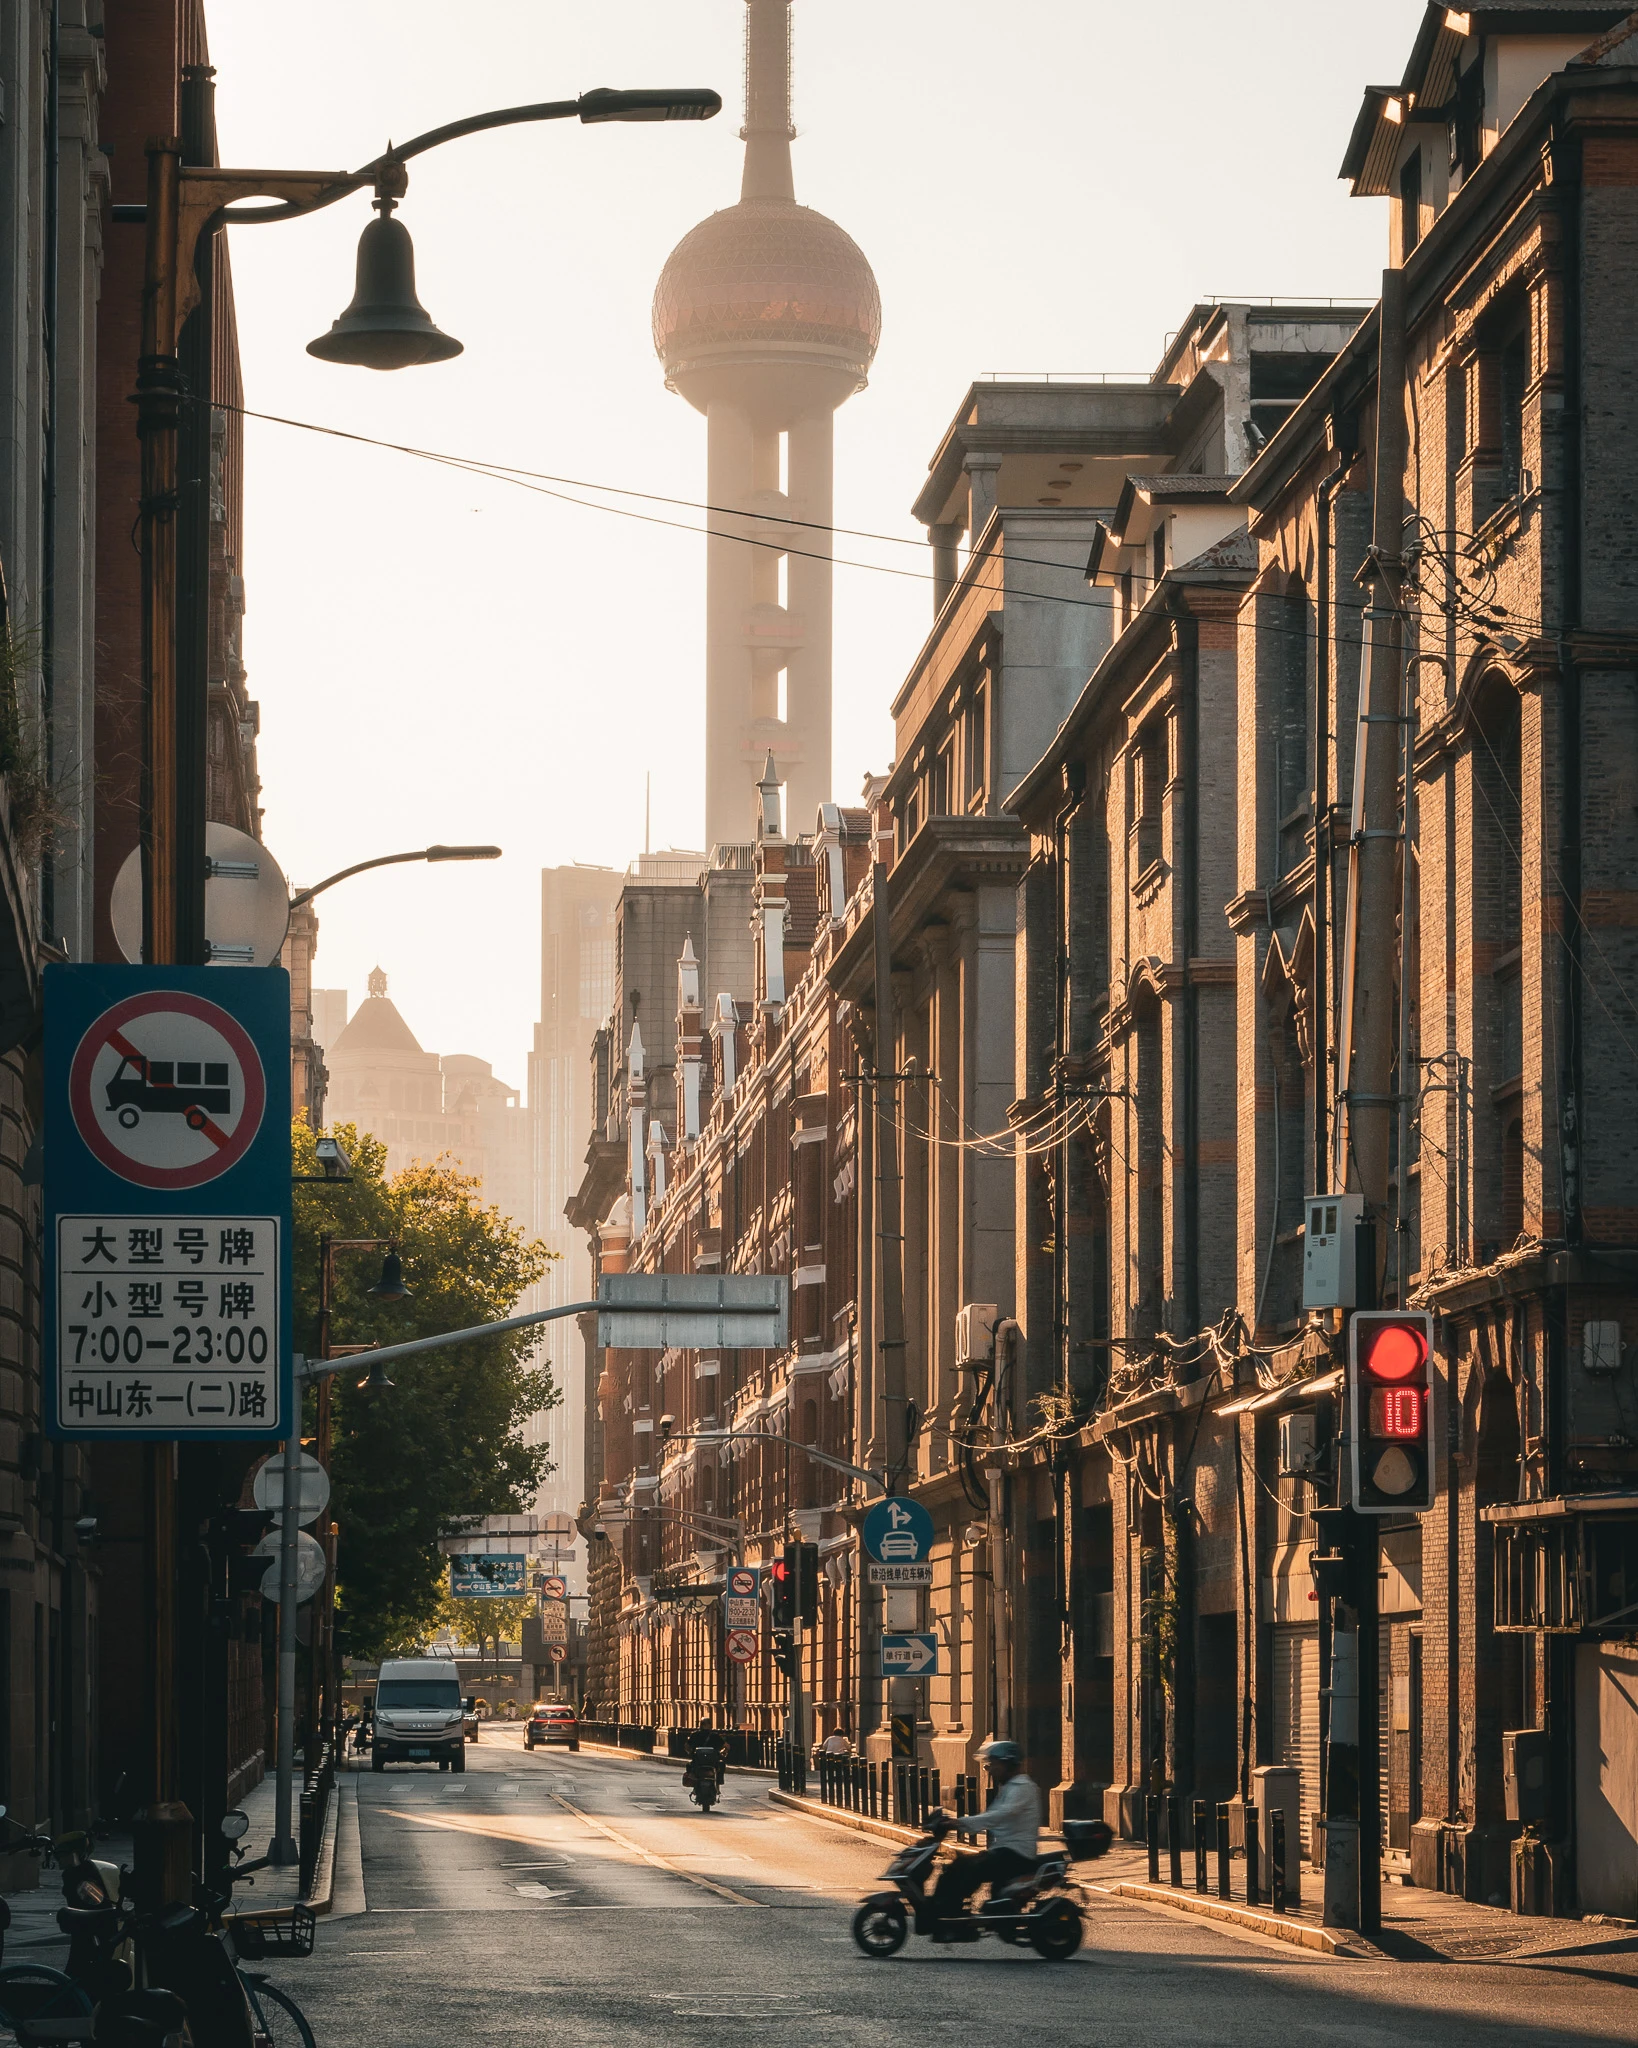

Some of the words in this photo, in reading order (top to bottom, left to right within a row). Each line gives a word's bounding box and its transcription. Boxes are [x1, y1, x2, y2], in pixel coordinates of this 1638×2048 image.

[81, 1226, 256, 1266] 大型号牌
[81, 1281, 256, 1319] 小型号牌
[68, 1325, 268, 1364] 7:00-23:00
[68, 1379, 268, 1418] 中山东一(二)路
[1386, 1390, 1418, 1433] 10
[871, 1567, 932, 1581] 除沿线单位车辆外
[729, 1599, 756, 1607] 中山东一路
[885, 1650, 911, 1661] 单行道
